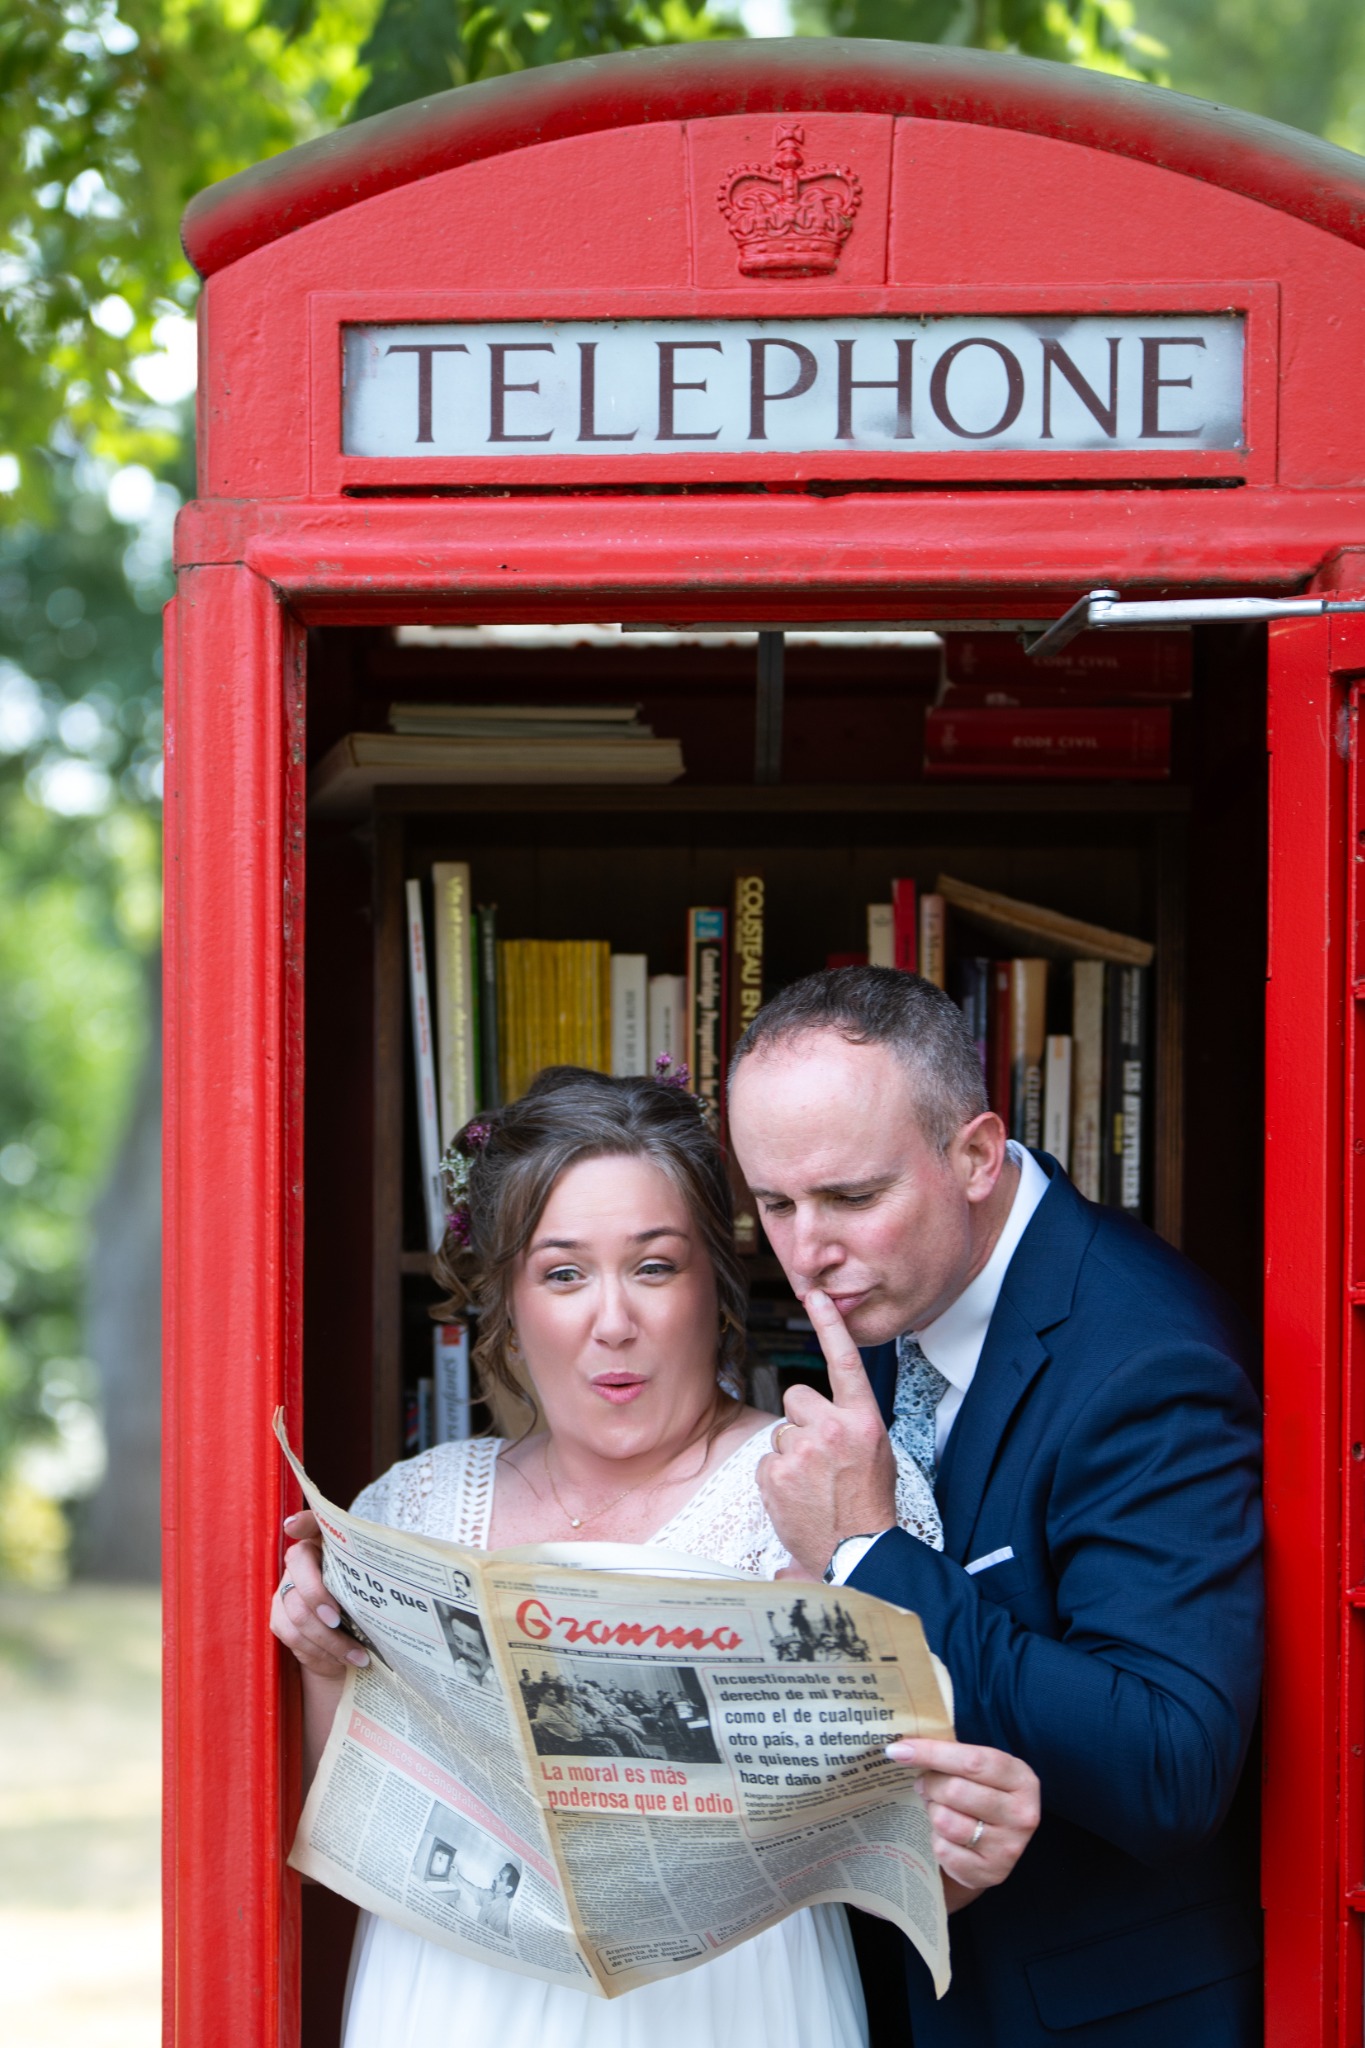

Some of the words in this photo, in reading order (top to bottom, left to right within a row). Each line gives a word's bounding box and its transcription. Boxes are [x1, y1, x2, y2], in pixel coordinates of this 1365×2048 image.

[385, 336, 1208, 443] TELEPHONE
[1031, 655, 1074, 668] CODE
[1078, 656, 1121, 669] CIVIL
[1011, 736, 1053, 749] CODE
[1057, 736, 1100, 749] CIVIL
[741, 876, 765, 983] COUSTEAU
[696, 947, 720, 1008] Cambridge
[740, 988, 762, 1018] EN
[696, 1010, 719, 1077] Preparation
[1122, 1060, 1142, 1091] LES
[1122, 1094, 1142, 1208] AVENTURIERS
[365, 1573, 384, 1593] lo
[390, 1588, 429, 1613] que
[515, 1599, 744, 1651] Granma
[713, 1673, 831, 1685] Incuestionable
[837, 1675, 856, 1684] es
[862, 1673, 877, 1684] el
[720, 1690, 780, 1701] derecho
[786, 1689, 805, 1701] de
[809, 1689, 828, 1700] mi
[832, 1689, 885, 1702] Patria,
[725, 1711, 766, 1724] como
[773, 1708, 786, 1723] el
[793, 1708, 812, 1723] de
[819, 1707, 895, 1725] cualquier
[729, 1733, 757, 1746] otro
[763, 1731, 800, 1748] país,
[804, 1735, 814, 1746] a
[820, 1732, 903, 1746] defenderse
[734, 1752, 752, 1764] de
[759, 1753, 819, 1768] quienes
[825, 1747, 888, 1767] intenta
[540, 1762, 563, 1781] La
[567, 1763, 620, 1782] moral
[624, 1766, 645, 1783] es
[651, 1765, 688, 1785] más
[739, 1769, 779, 1787] hacer
[786, 1773, 822, 1787] daño
[826, 1774, 837, 1783] a
[840, 1766, 859, 1778] su
[546, 1787, 629, 1809] poderosa
[634, 1793, 666, 1815] que
[672, 1791, 689, 1811] el
[695, 1793, 734, 1814] odio
[605, 1942, 651, 1956] Argentinos
[608, 1949, 646, 1962] renuncia
[611, 1960, 623, 1968] de
